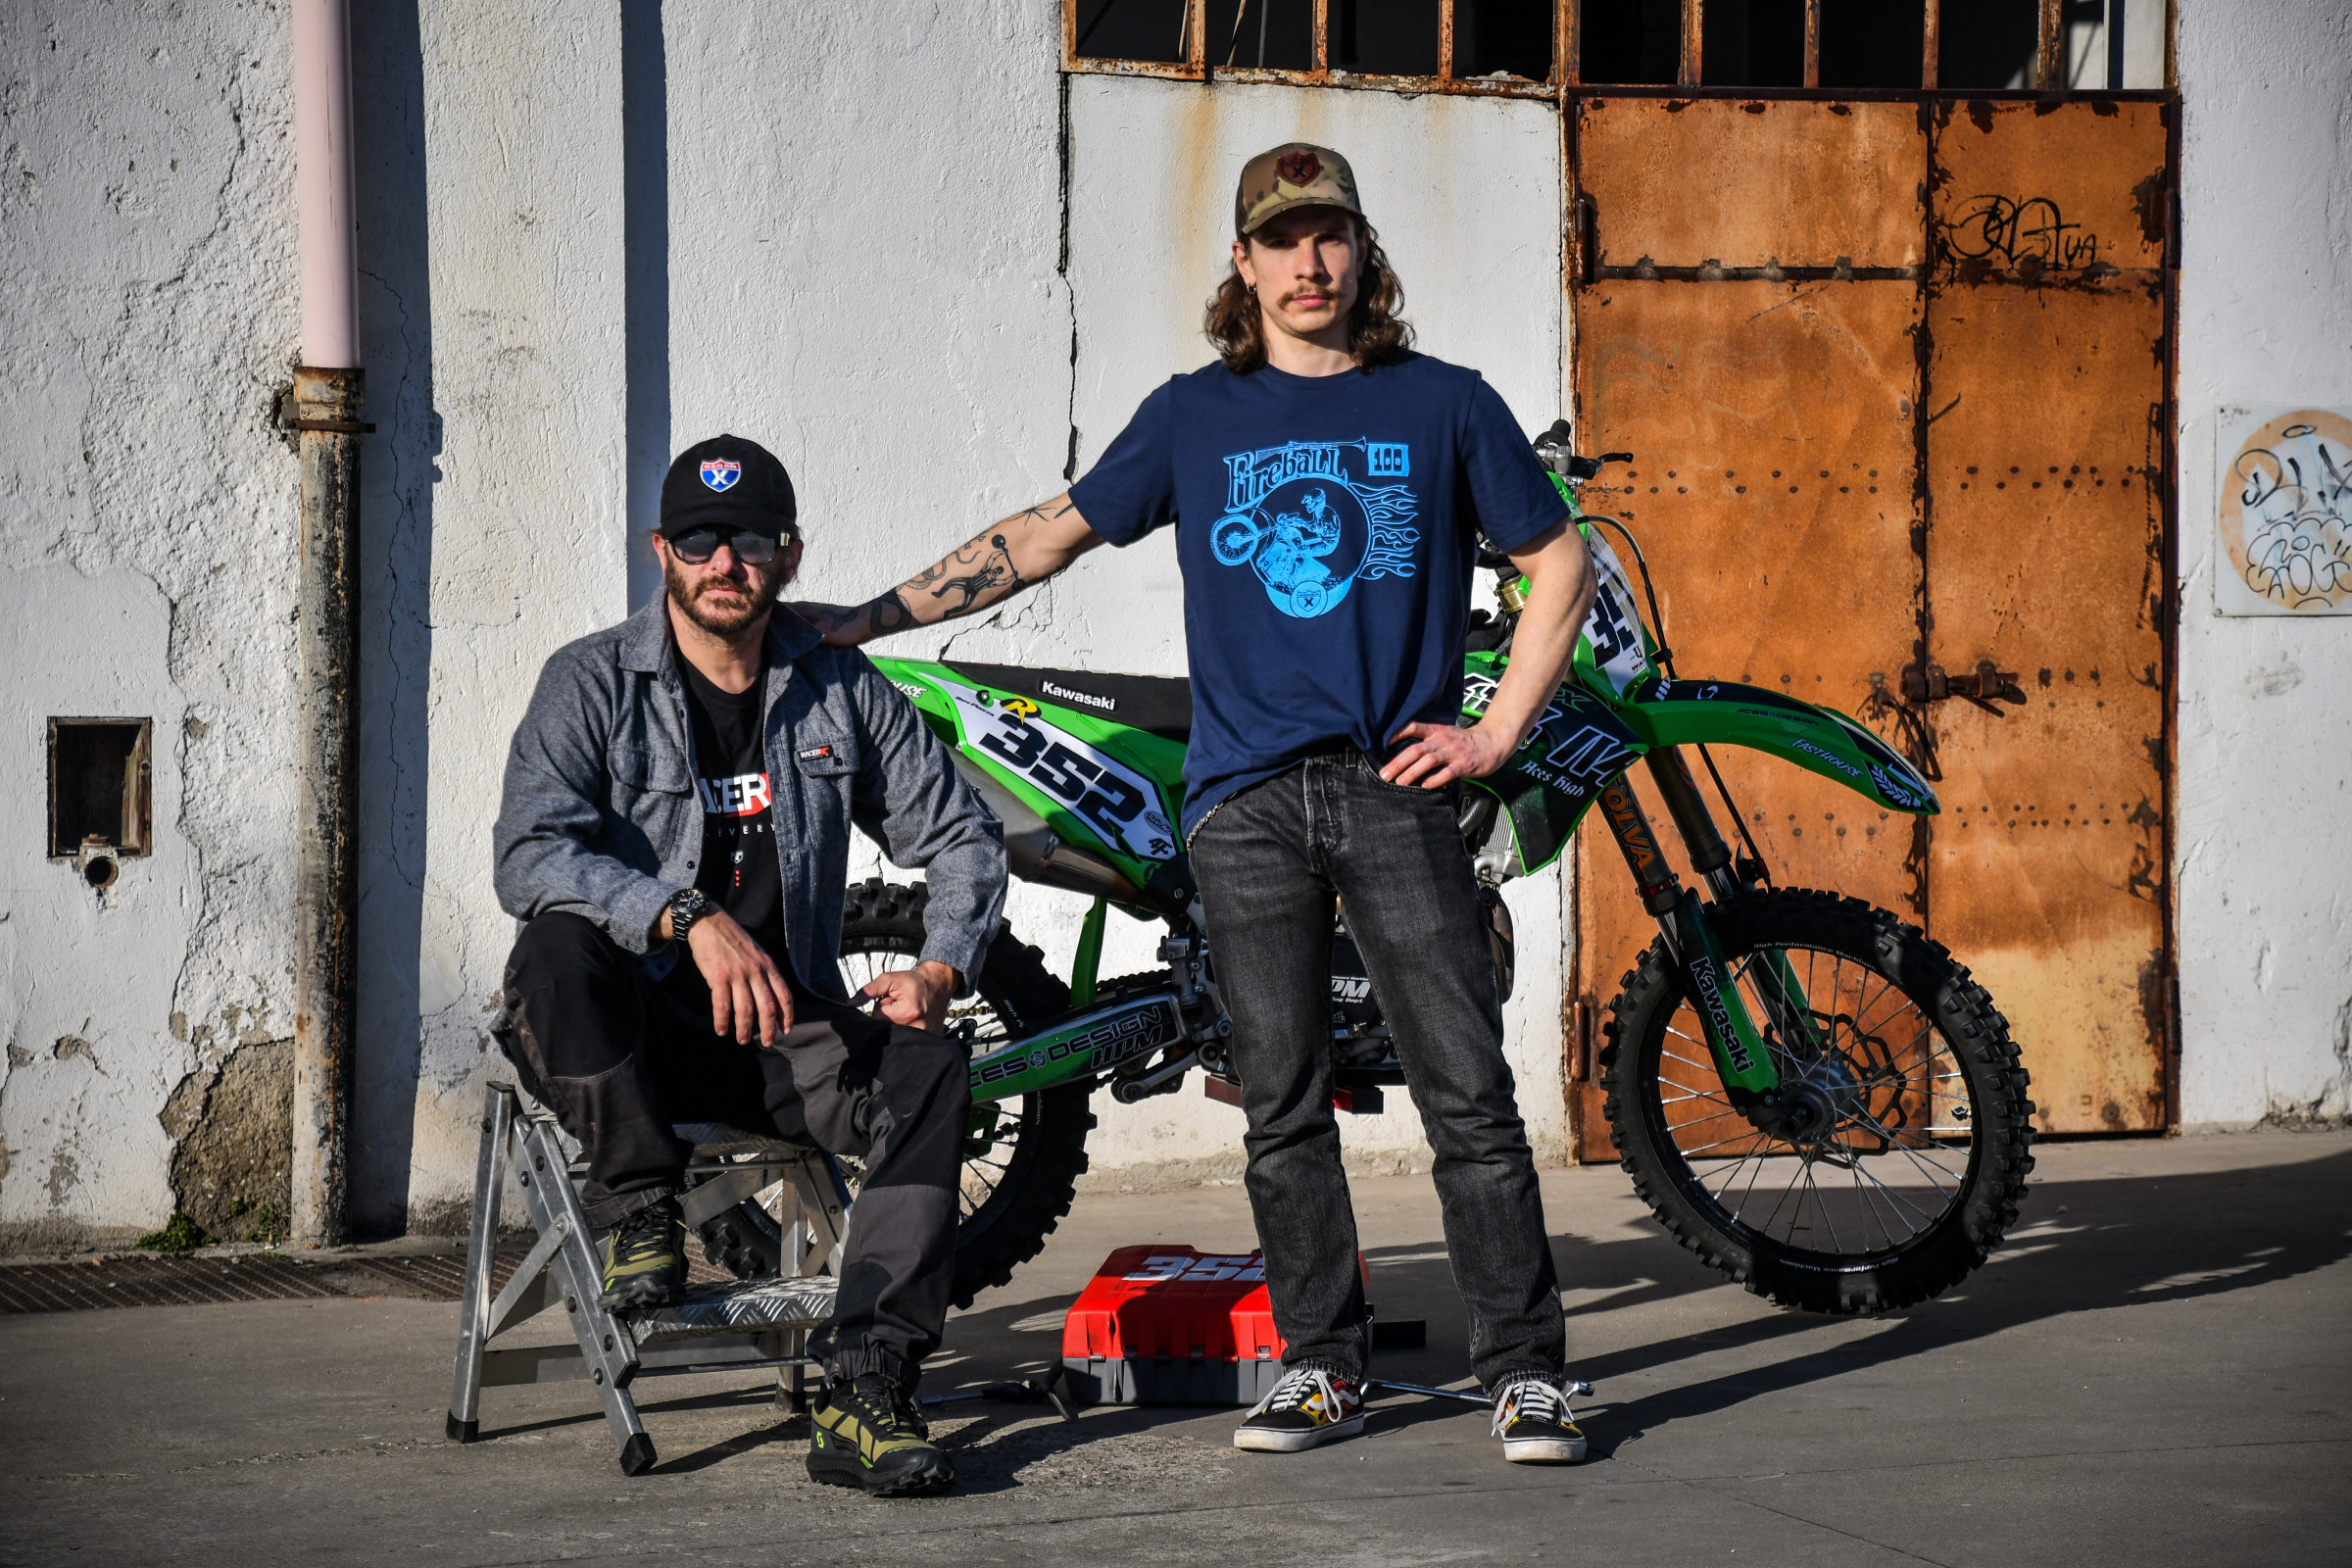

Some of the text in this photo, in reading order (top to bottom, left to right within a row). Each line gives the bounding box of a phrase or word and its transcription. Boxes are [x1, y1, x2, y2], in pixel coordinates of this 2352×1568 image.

[710, 469, 729, 486] X
[1373, 447, 1403, 472] 100
[1303, 597, 1314, 608] X
[1042, 680, 1115, 710] Kawasaki
[1776, 712, 1820, 726] DESIGN
[979, 712, 1148, 839] 352
[1790, 738, 1865, 779] FASTHOUSE
[1517, 760, 1586, 798] Aces High
[1604, 775, 1656, 872] ÖLVA
[1047, 1005, 1162, 1062] DESIGN
[1690, 956, 1755, 1075] Kawasaki
[1091, 1024, 1163, 1070] HPM
